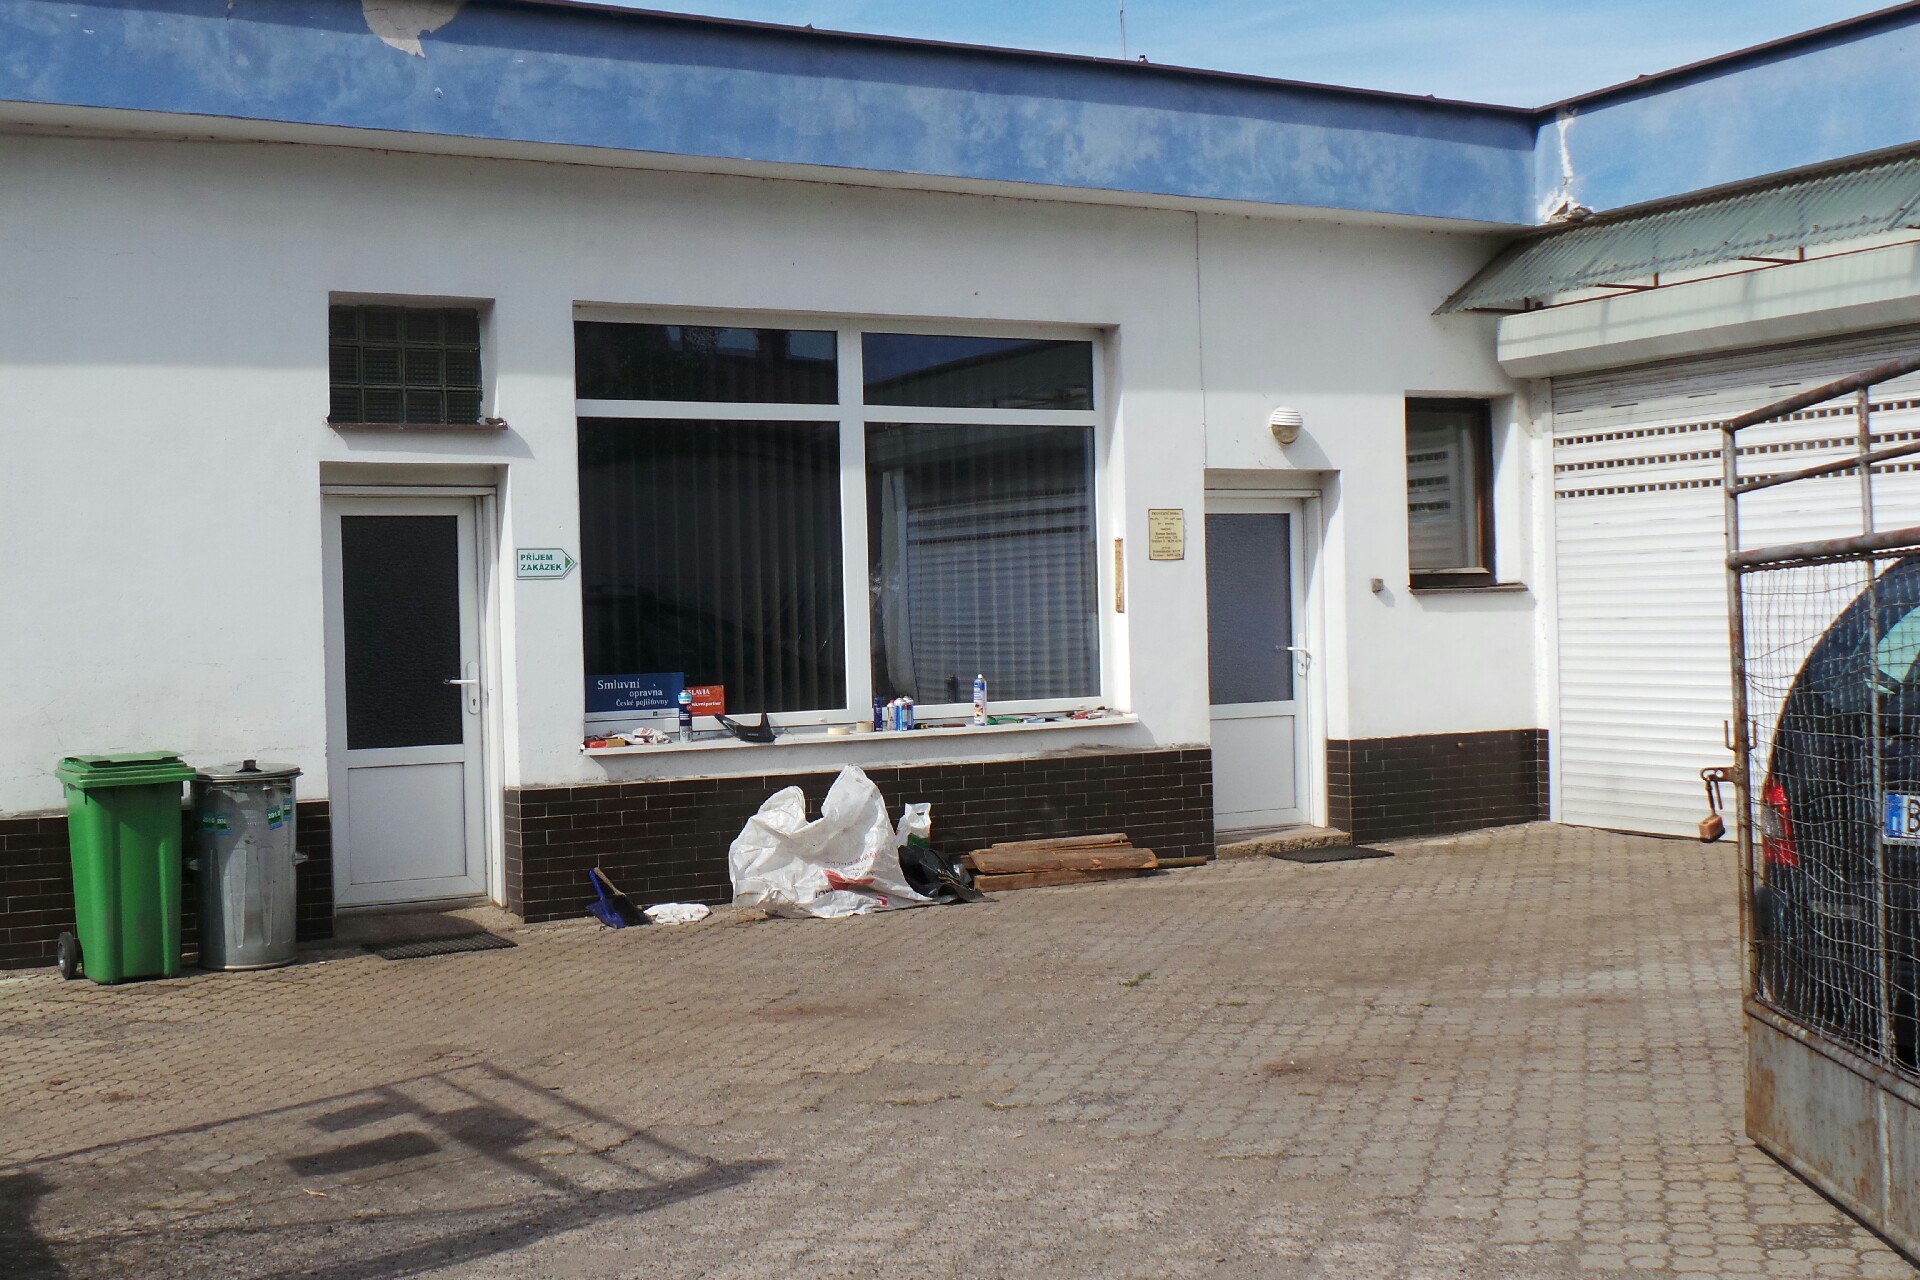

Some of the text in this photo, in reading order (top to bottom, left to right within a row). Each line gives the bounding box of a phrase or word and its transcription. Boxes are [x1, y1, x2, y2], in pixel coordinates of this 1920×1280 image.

[520, 552, 553, 561] PŘÍJEM
[520, 563, 562, 571] ZAKÁZEK
[597, 678, 640, 690] Smluvní
[629, 689, 663, 698] opravna
[615, 699, 669, 708] České pojišťovny
